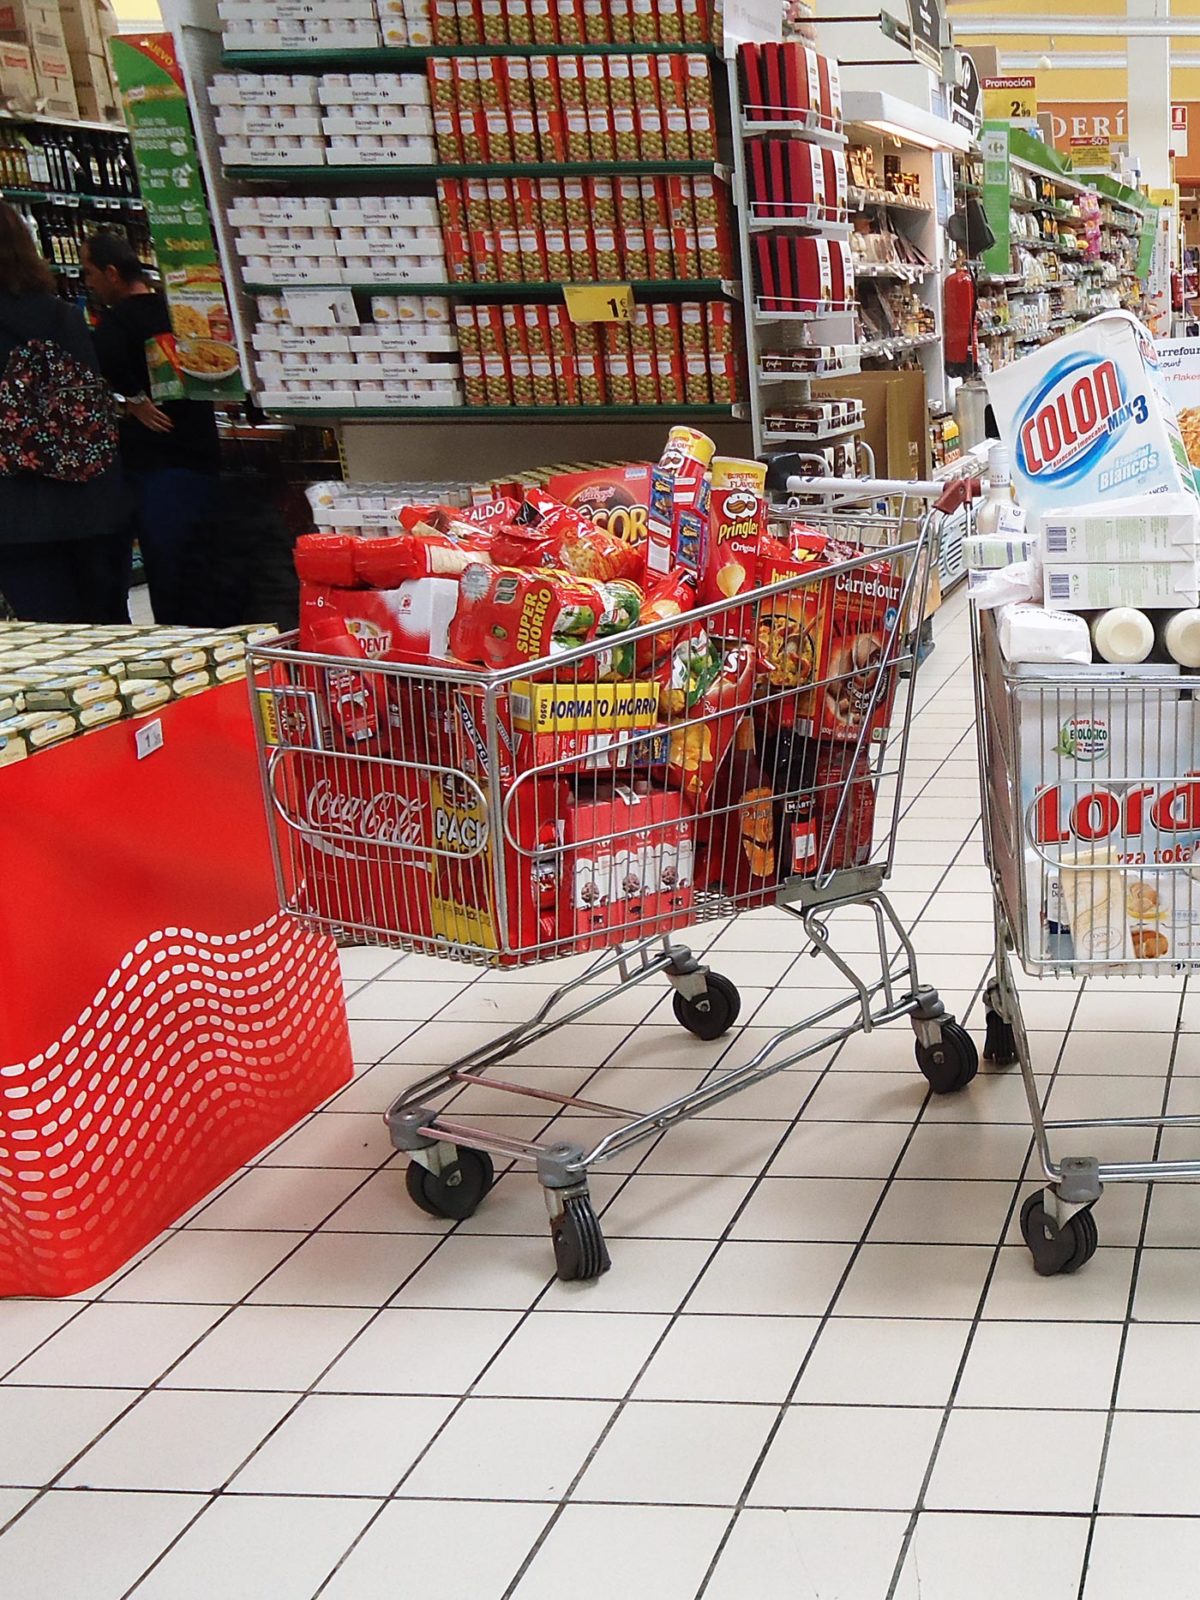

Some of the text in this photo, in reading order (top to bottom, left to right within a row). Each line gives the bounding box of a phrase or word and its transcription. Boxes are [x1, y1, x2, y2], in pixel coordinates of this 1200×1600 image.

[985, 78, 1032, 89] Promoción
[607, 298, 619, 318] 1
[1160, 358, 1182, 368] count
[1020, 360, 1124, 476] COLON
[1107, 394, 1150, 433] MAX 3
[1099, 451, 1159, 493] Blancos
[467, 500, 506, 521] ALDO
[718, 518, 759, 546] Pringles
[731, 541, 757, 554] Original
[836, 573, 900, 601] Carrefour
[516, 592, 538, 654] SUPER
[528, 588, 551, 662] AHORRO
[550, 697, 657, 719] FORMATO AHORRO
[1070, 728, 1108, 740] EOLÓICO
